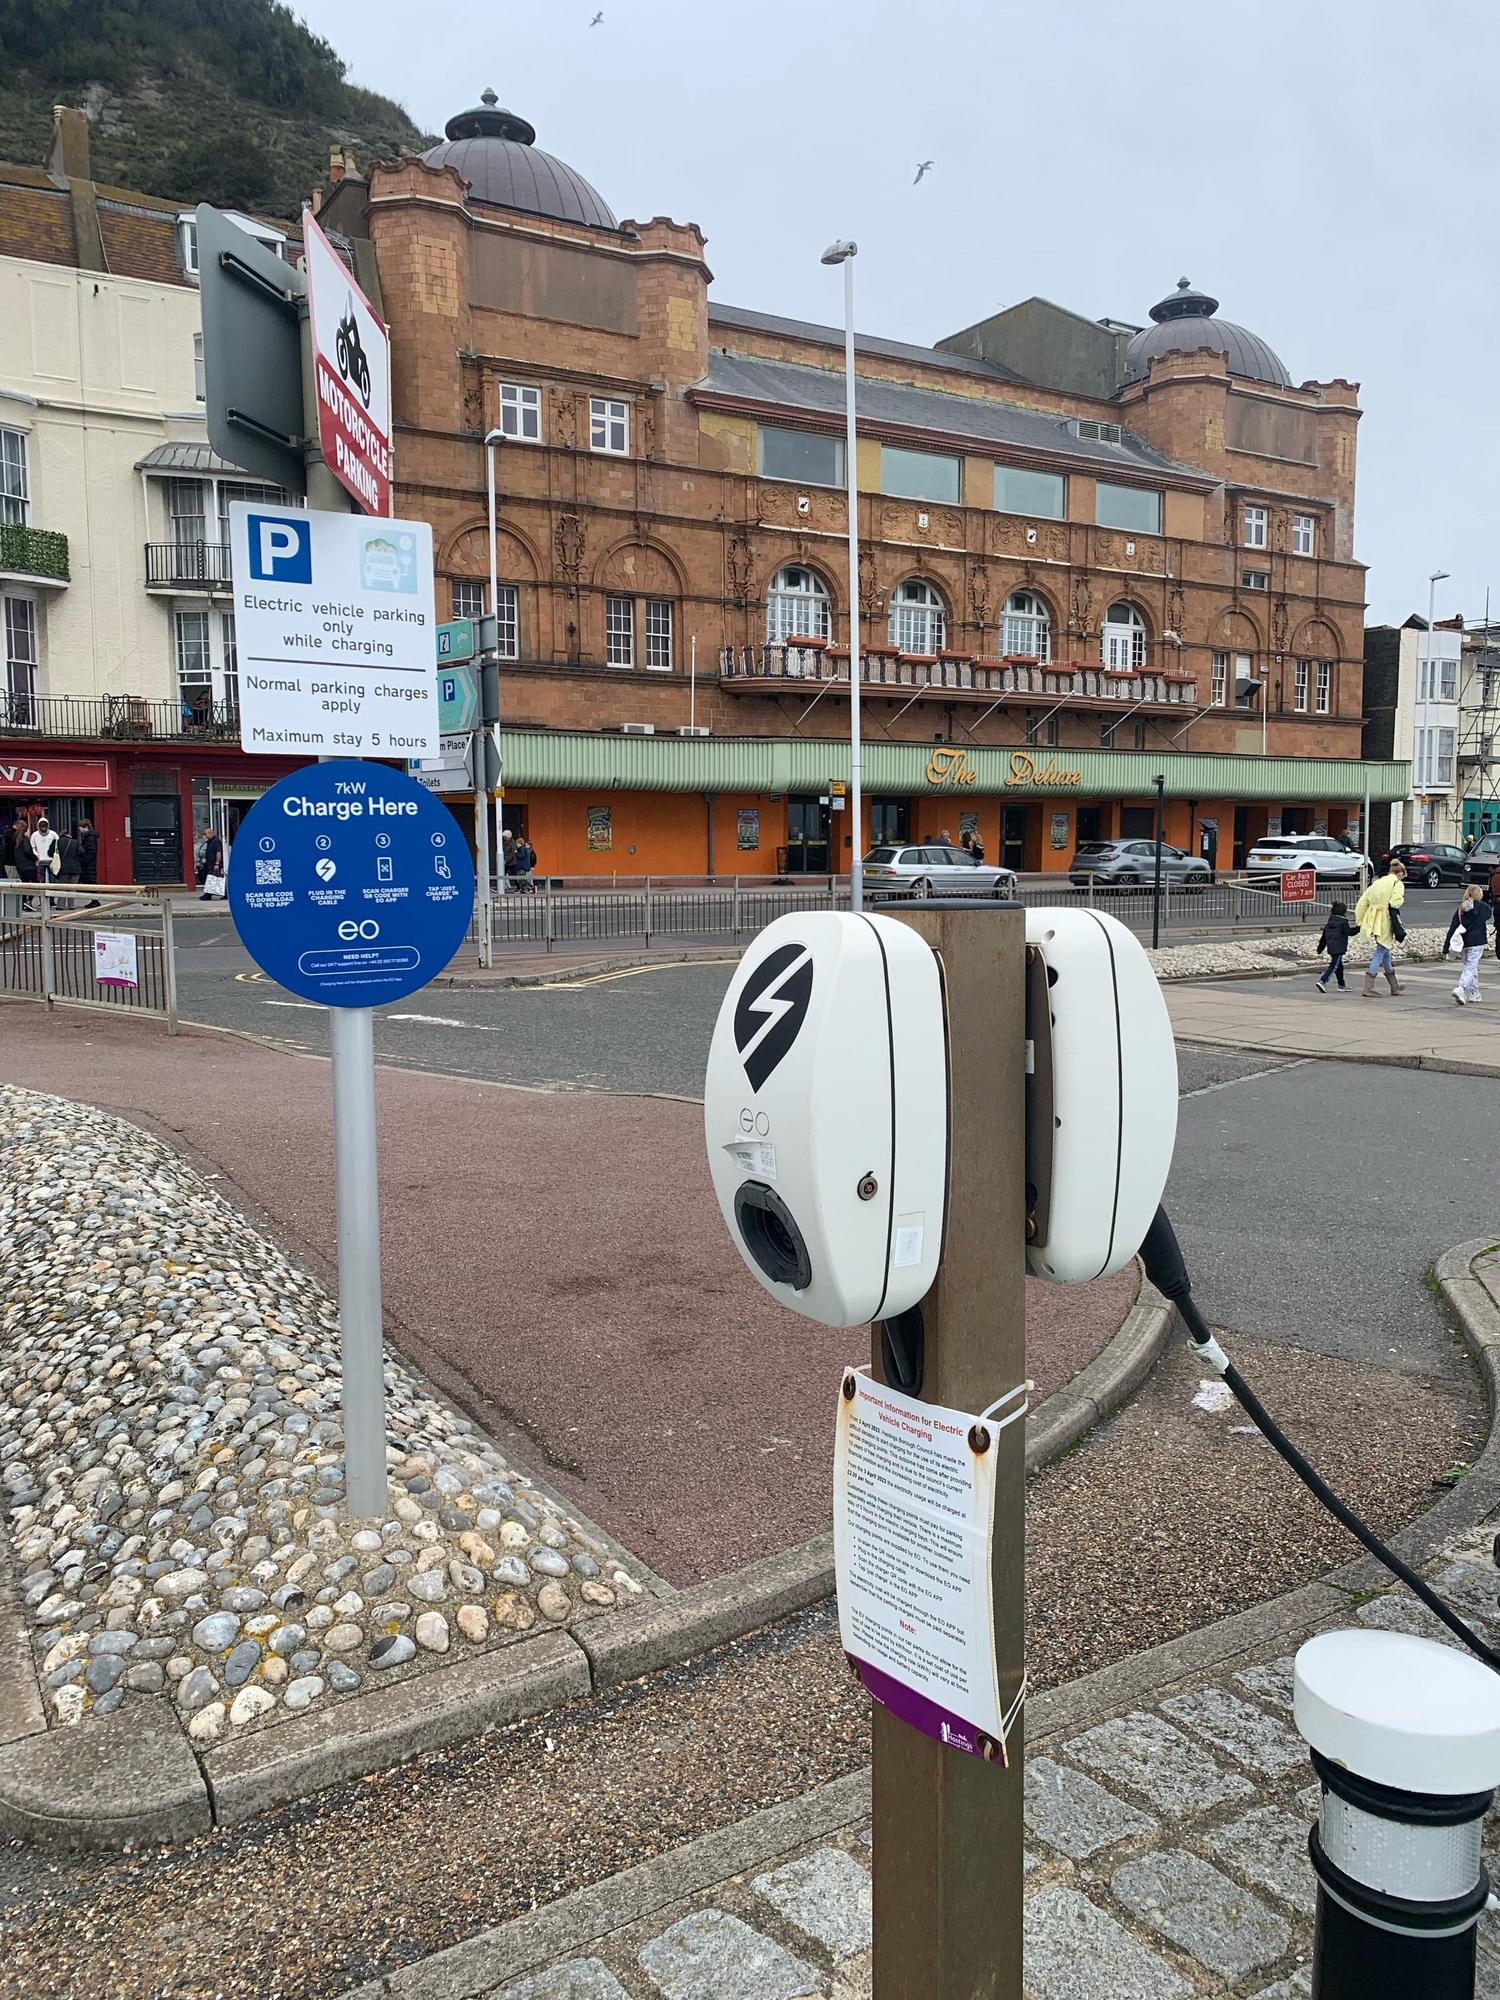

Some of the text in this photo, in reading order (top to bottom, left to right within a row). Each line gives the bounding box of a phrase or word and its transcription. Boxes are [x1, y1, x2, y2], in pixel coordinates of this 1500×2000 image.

[318, 364, 388, 479] MOTORCYCLE
[335, 433, 379, 512] PARKING
[259, 522, 299, 575] P
[244, 595, 425, 626] Electric vehicle parking
[323, 621, 354, 636] only
[283, 634, 393, 656] while charging
[247, 676, 428, 700] Normal parking charges
[446, 682, 453, 699] P
[322, 699, 360, 714] apply
[252, 728, 324, 744] Maximum
[333, 733, 362, 747] stay
[372, 734, 380, 746] 5
[390, 735, 427, 748] hours
[447, 740, 465, 750] Place
[926, 748, 1082, 785] The Deluxe
[334, 782, 367, 794] 7kW
[283, 797, 418, 820] Charge Here
[859, 1389, 964, 1437] Important Information for Electric
[878, 1412, 933, 1442] Vehicle Charging
[916, 1443, 932, 1456] Council
[950, 1474, 971, 1490] providing
[899, 1619, 917, 1636] Note:
